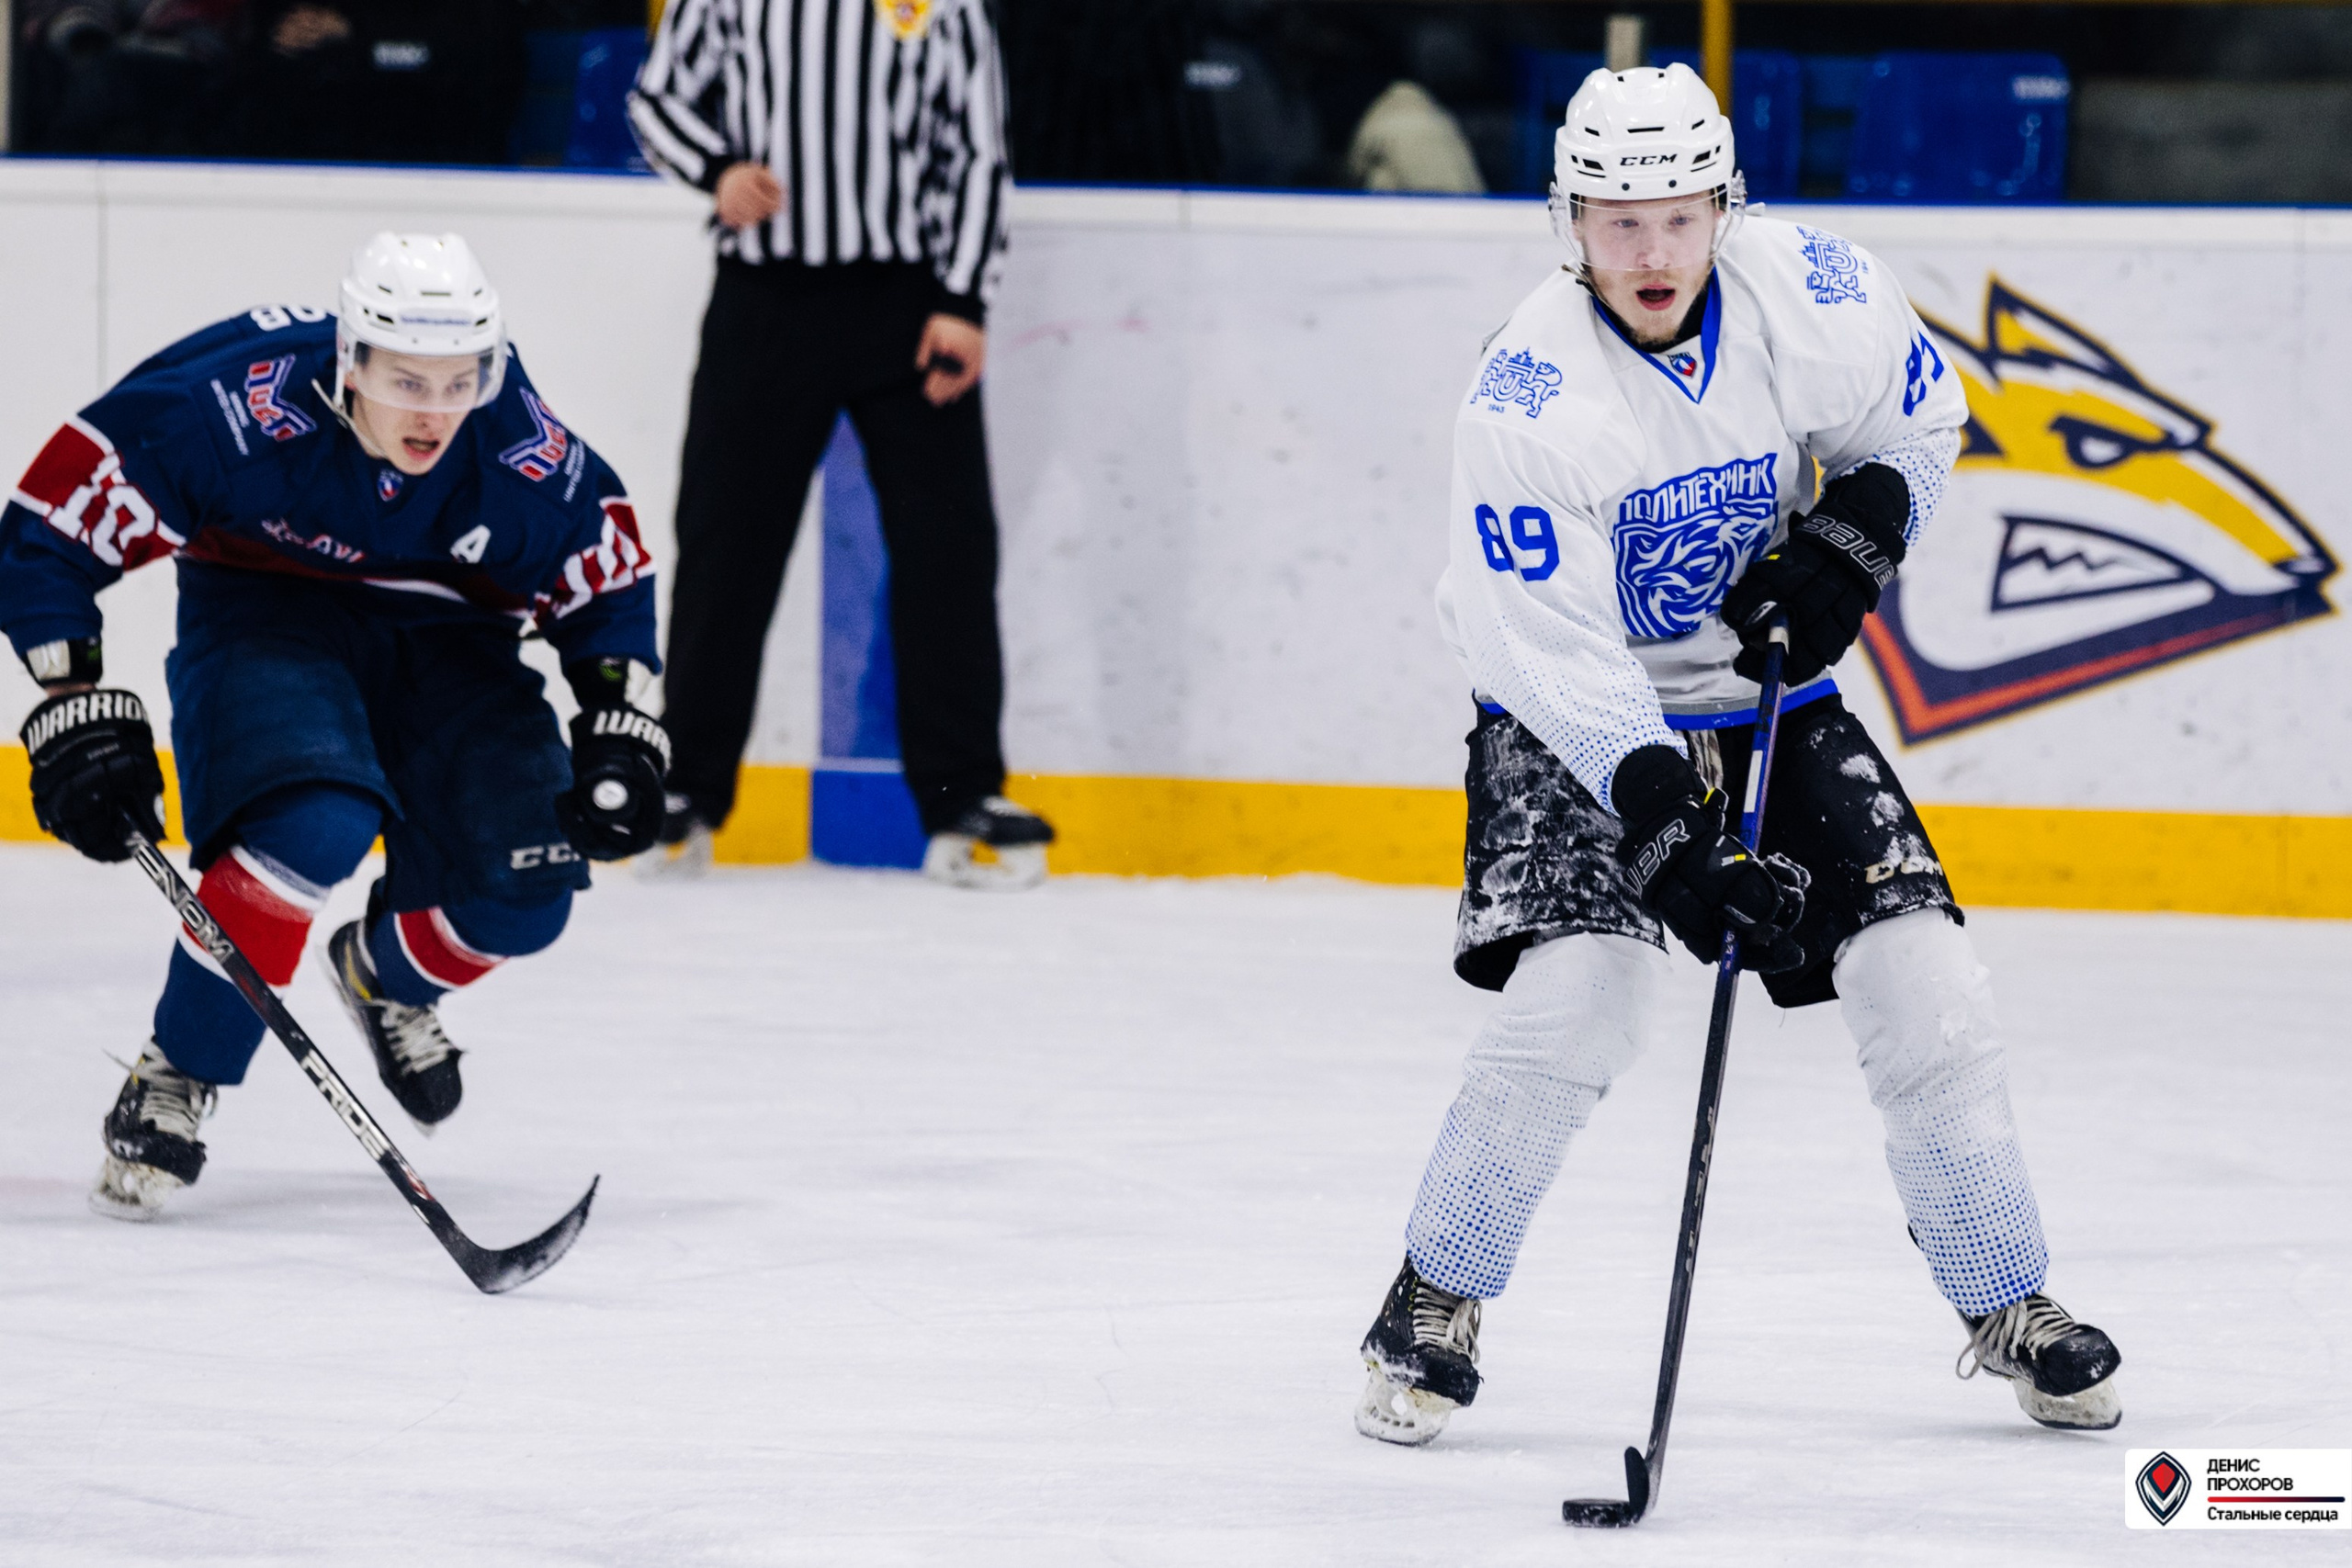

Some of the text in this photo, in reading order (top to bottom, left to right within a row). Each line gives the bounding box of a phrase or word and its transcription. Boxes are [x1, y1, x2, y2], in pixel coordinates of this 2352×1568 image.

[1619, 153, 1678, 166] CCM
[450, 525, 492, 564] A
[1475, 503, 1560, 581] 89
[1800, 514, 1894, 591] BAUE
[27, 693, 150, 758] WARRIO
[510, 841, 581, 871] CC
[300, 1048, 391, 1161] PRIDE
